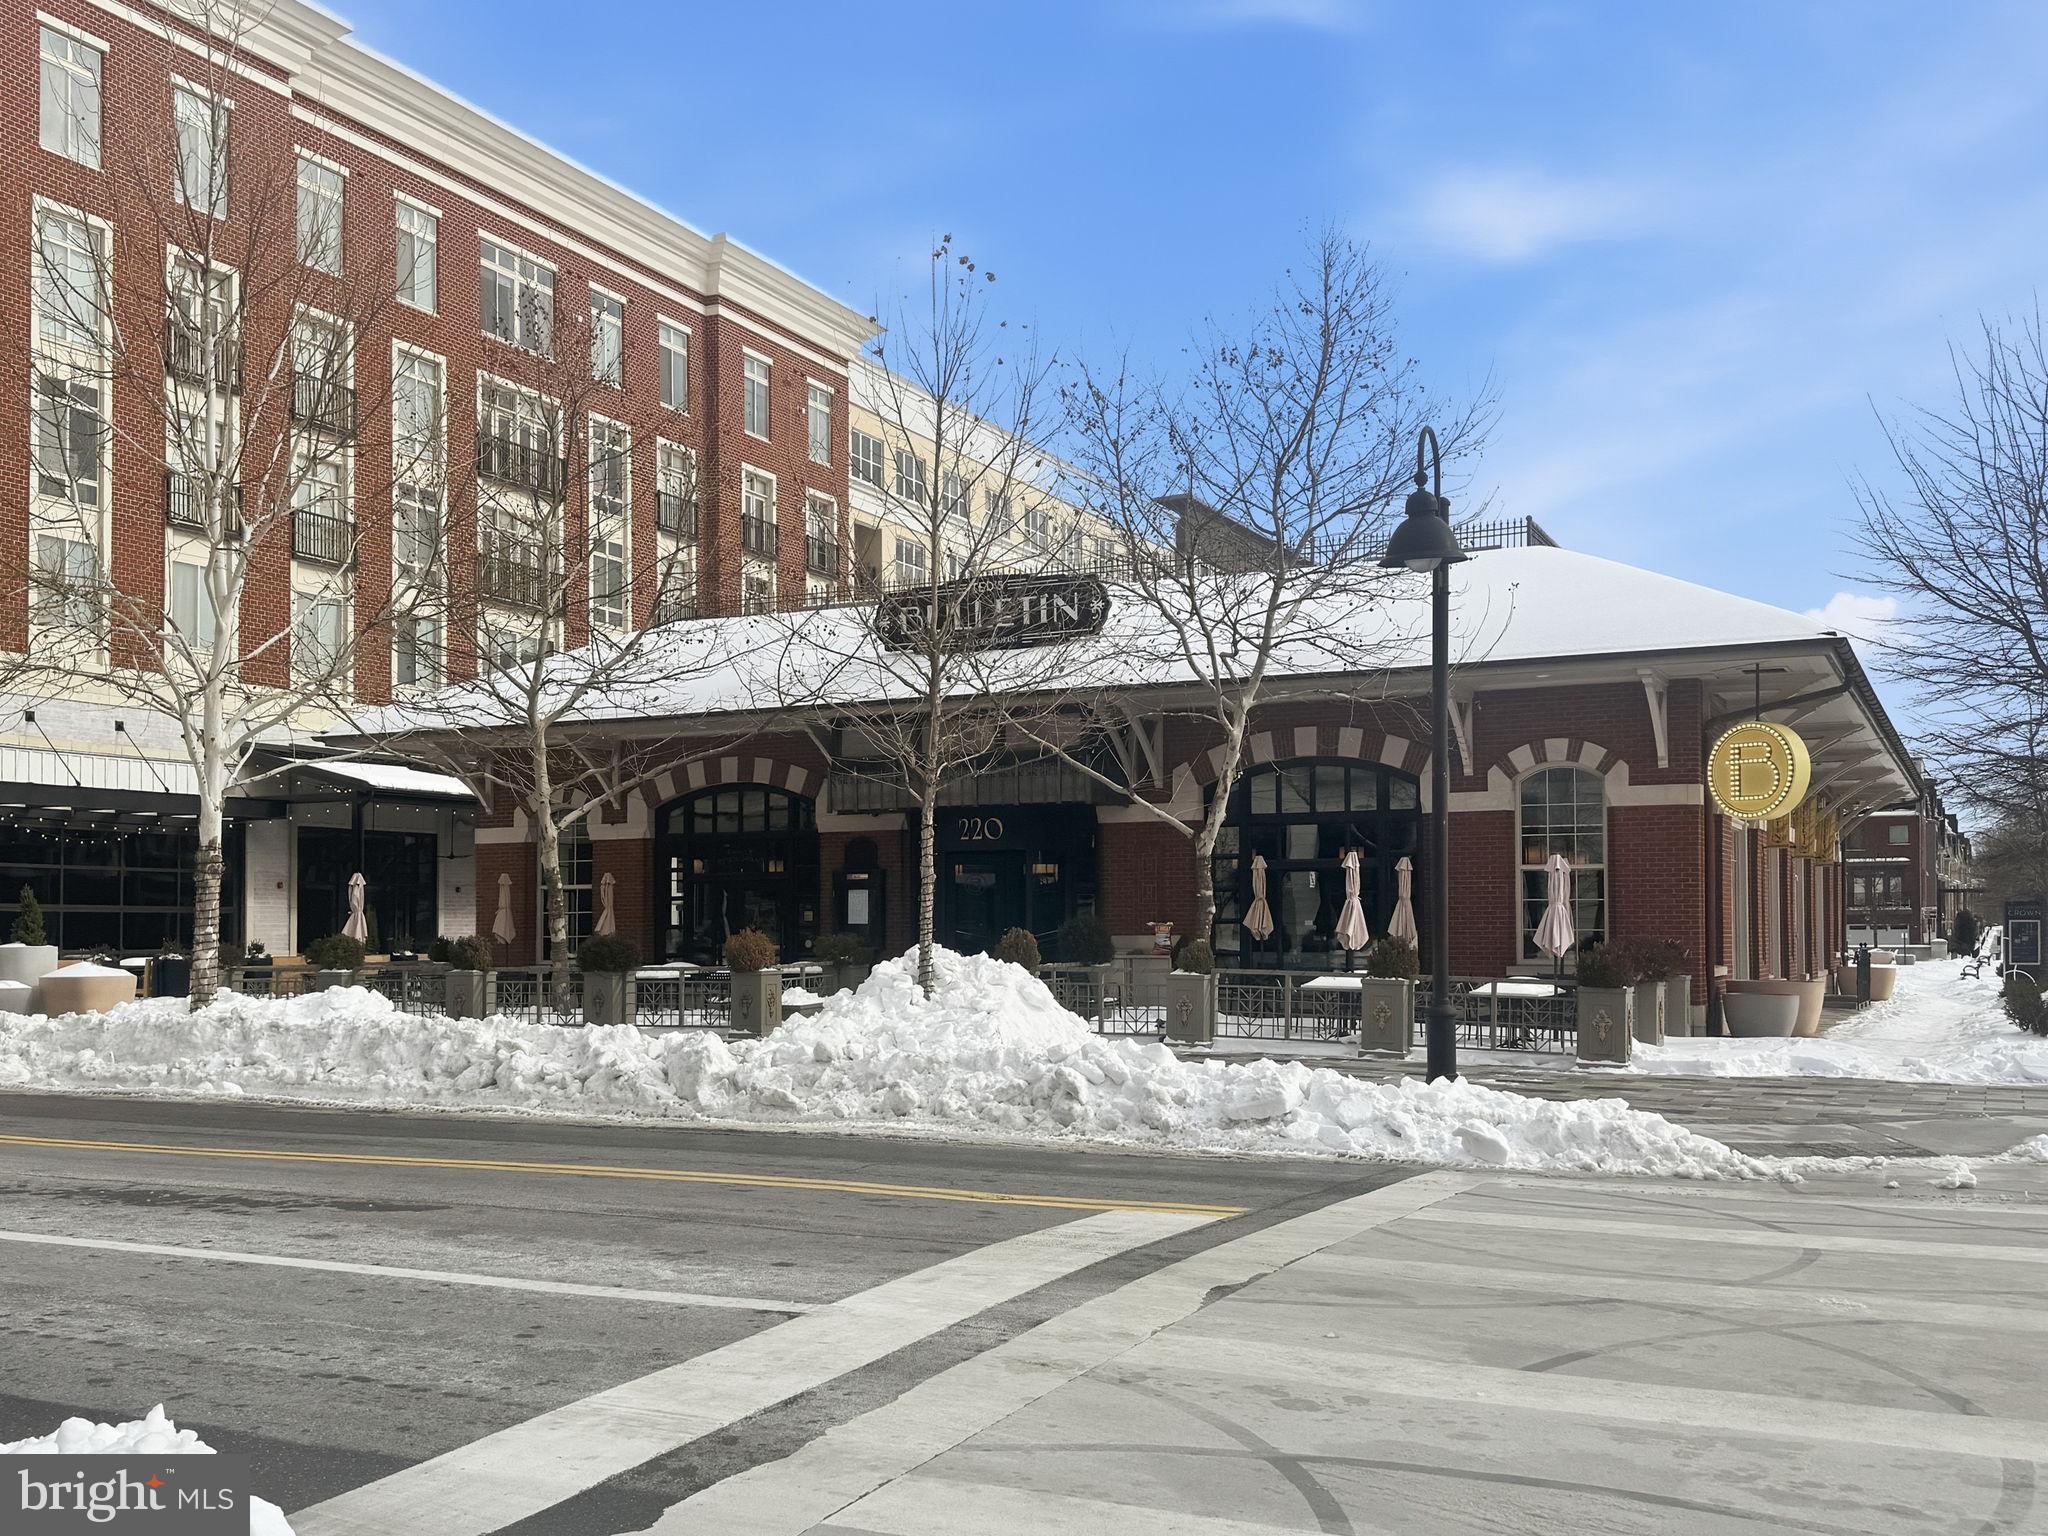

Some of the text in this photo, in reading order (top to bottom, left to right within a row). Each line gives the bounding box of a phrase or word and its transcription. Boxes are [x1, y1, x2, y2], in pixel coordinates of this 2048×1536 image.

[899, 591, 1079, 635] BULLETIN
[1726, 742, 1780, 801] B
[958, 817, 1004, 840] 220
